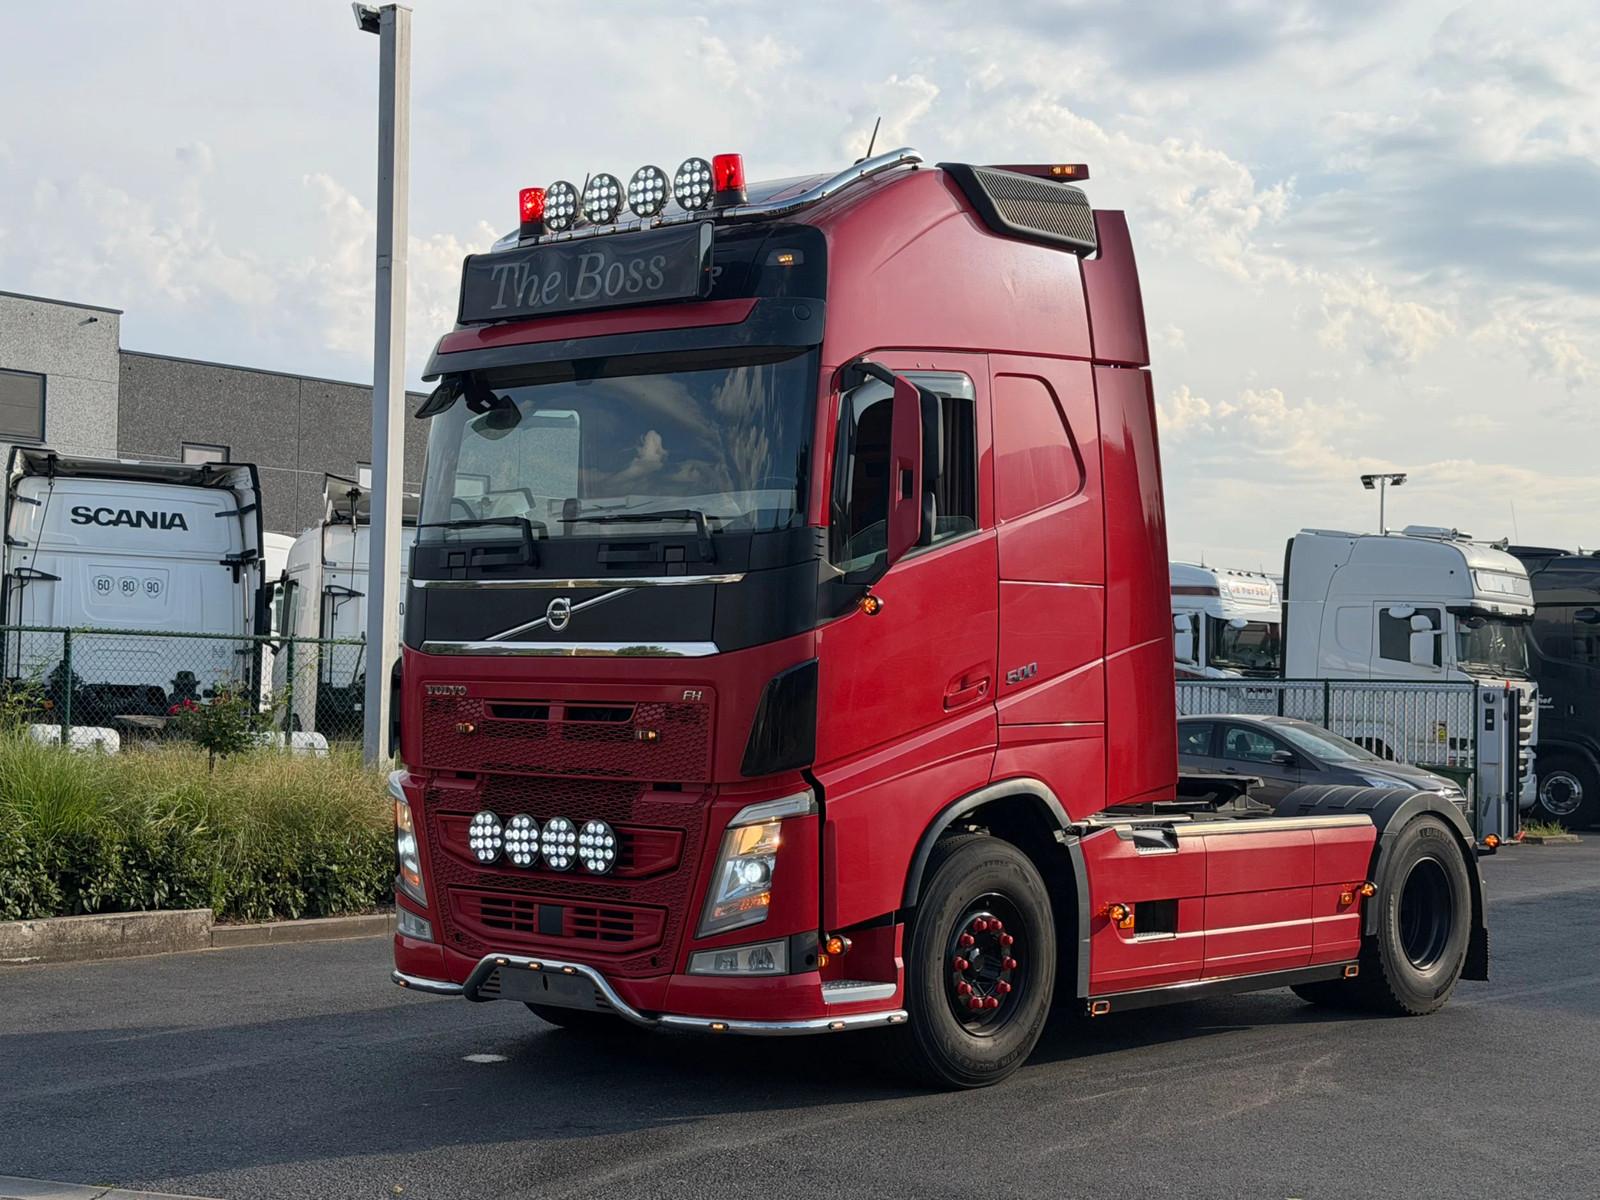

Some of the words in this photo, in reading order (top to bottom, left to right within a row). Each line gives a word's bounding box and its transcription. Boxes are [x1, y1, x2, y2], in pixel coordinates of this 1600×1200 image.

[490, 262, 562, 310] The
[570, 251, 667, 301] Boss
[70, 506, 189, 532] SCANIA
[97, 579, 110, 591] 60
[122, 580, 135, 592] 80
[146, 581, 160, 593] 90
[1006, 662, 1038, 685] 500
[425, 684, 467, 696] VOLVO
[682, 690, 702, 701] FH
